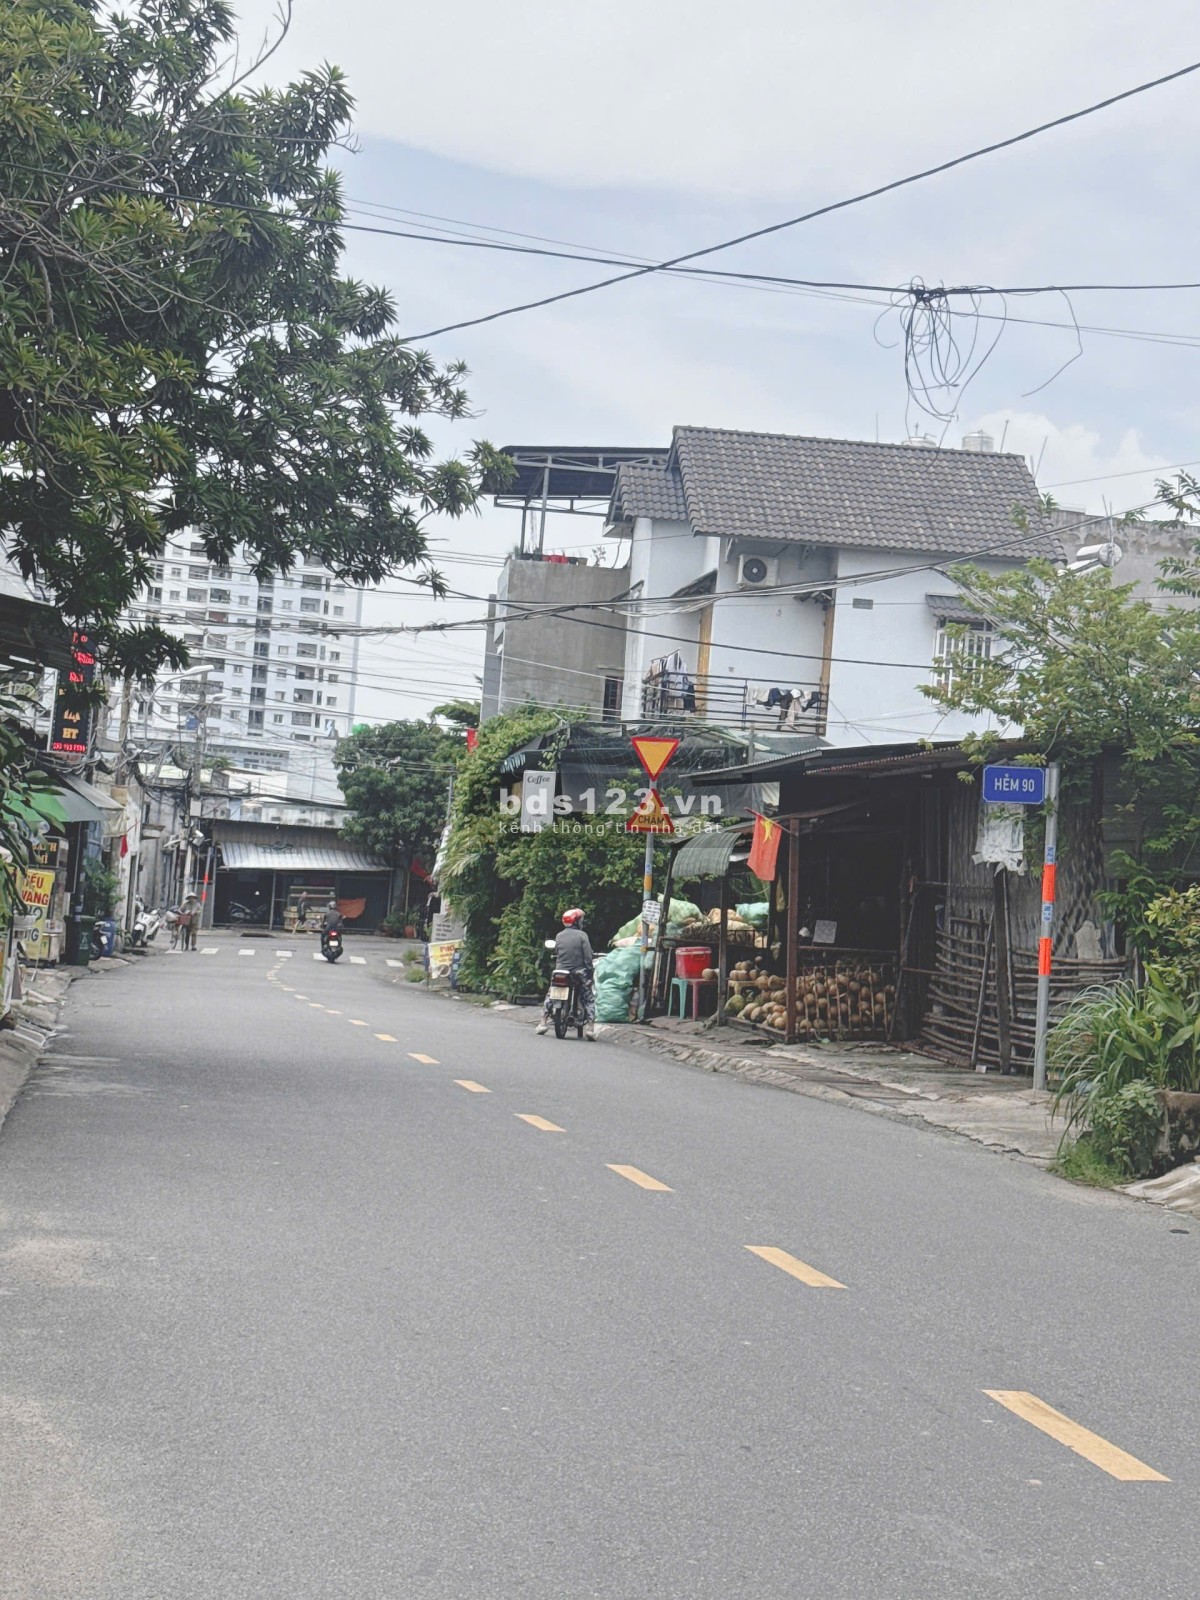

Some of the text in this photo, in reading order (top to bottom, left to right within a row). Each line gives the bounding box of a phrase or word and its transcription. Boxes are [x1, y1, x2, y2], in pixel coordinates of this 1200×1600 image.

[527, 775, 550, 784] Coffee
[994, 773, 1035, 792] HẺM 90
